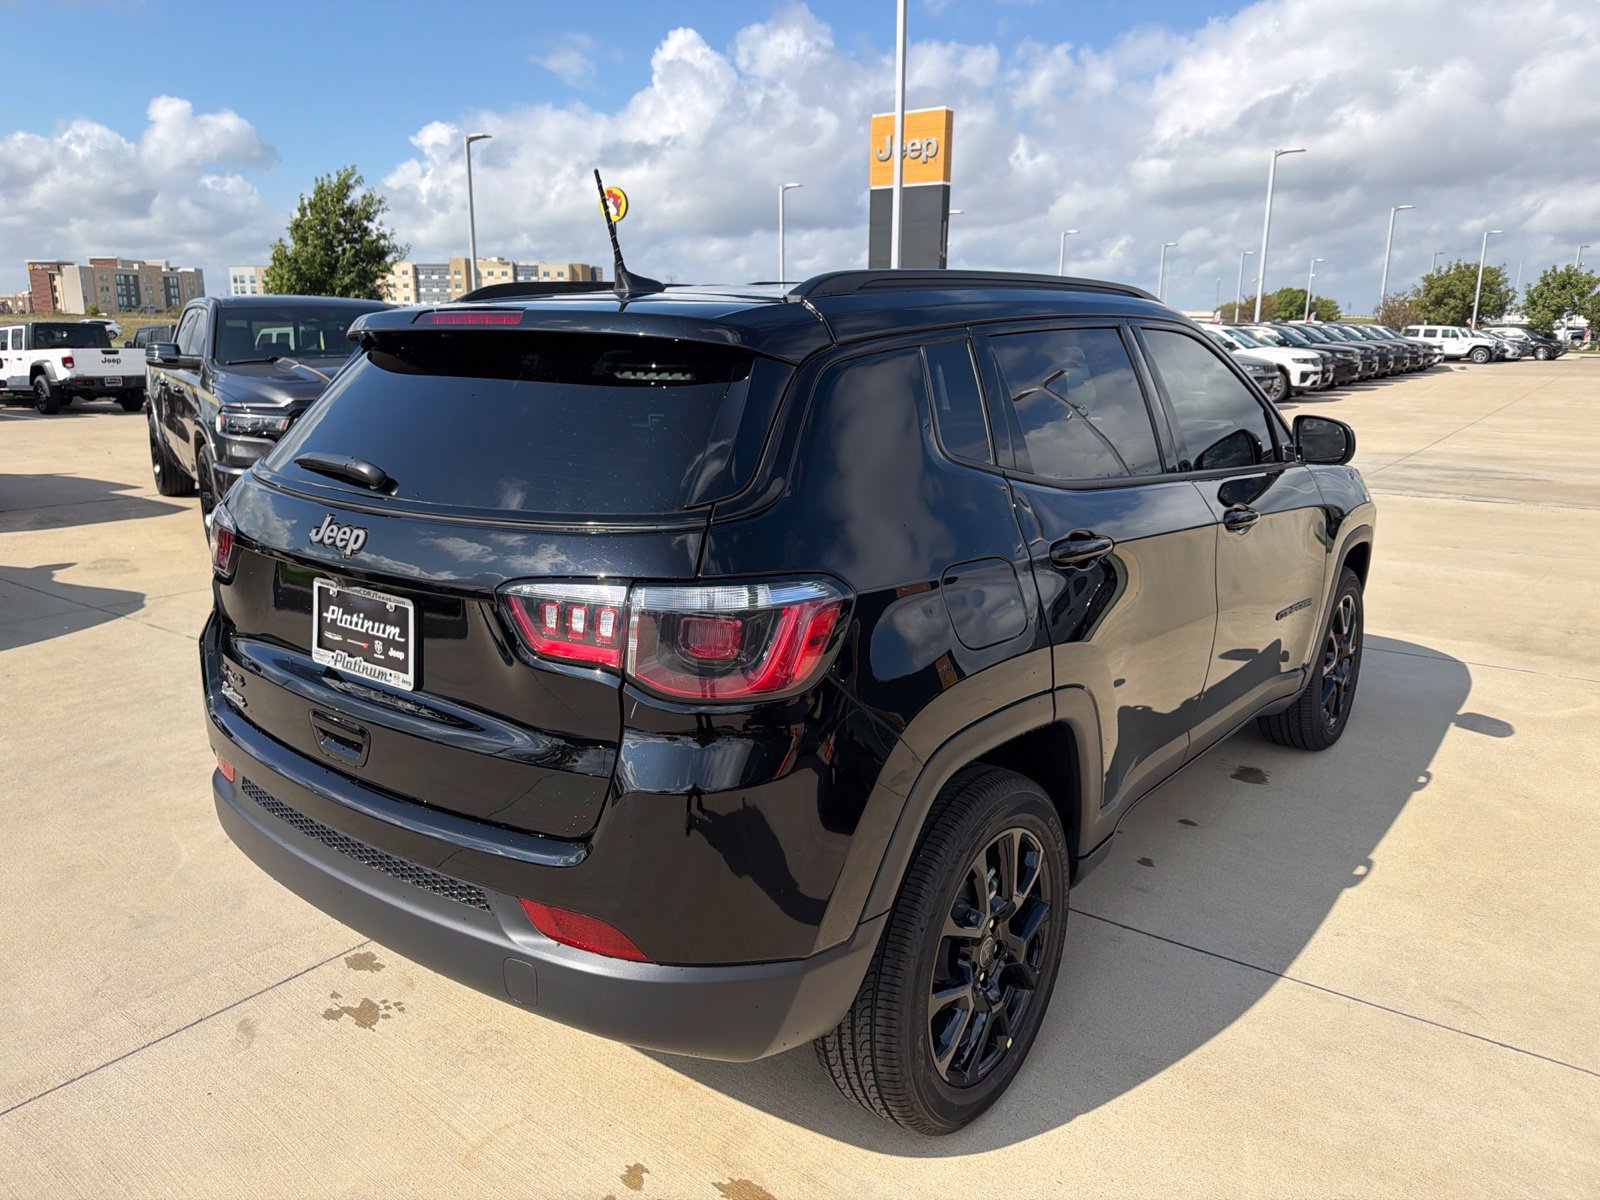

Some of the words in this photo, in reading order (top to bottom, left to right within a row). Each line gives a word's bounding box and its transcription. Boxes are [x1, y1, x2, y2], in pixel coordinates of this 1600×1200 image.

[101, 356, 121, 365] Jeep
[310, 513, 367, 558] Jeep
[319, 580, 406, 606] www.PnumCDRJTexas.com
[323, 605, 406, 642] Platinum
[333, 651, 391, 683] Platinum
[388, 647, 405, 661] Jeep
